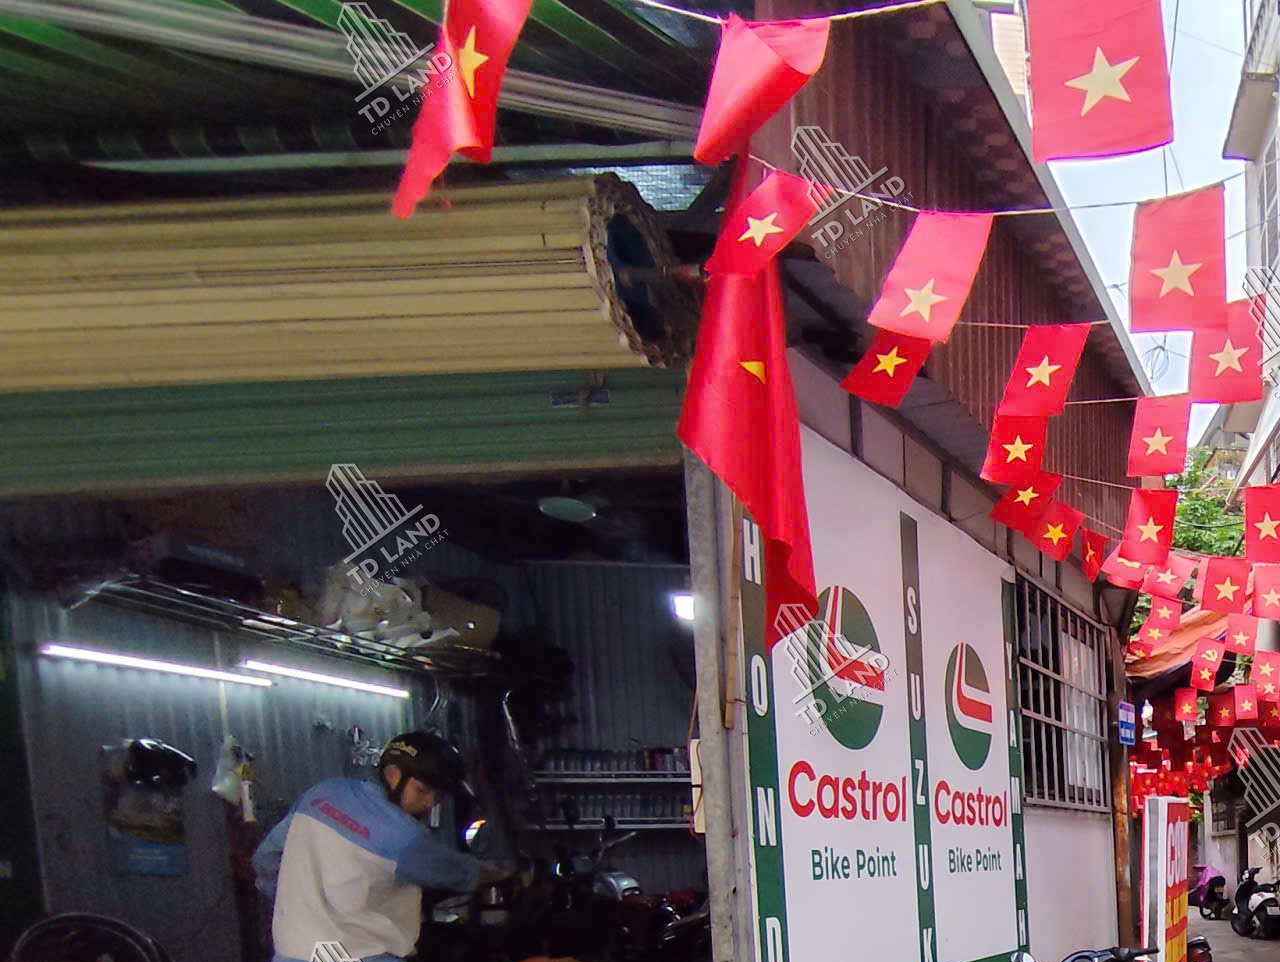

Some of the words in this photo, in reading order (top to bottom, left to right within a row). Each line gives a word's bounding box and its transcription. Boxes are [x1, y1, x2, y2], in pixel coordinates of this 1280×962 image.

[787, 760, 907, 822] Castrol
[933, 780, 1008, 827] Castrol
[810, 846, 851, 881] Bike
[855, 846, 897, 879] Point
[948, 846, 973, 874] Bike
[975, 846, 1002, 873] Point
